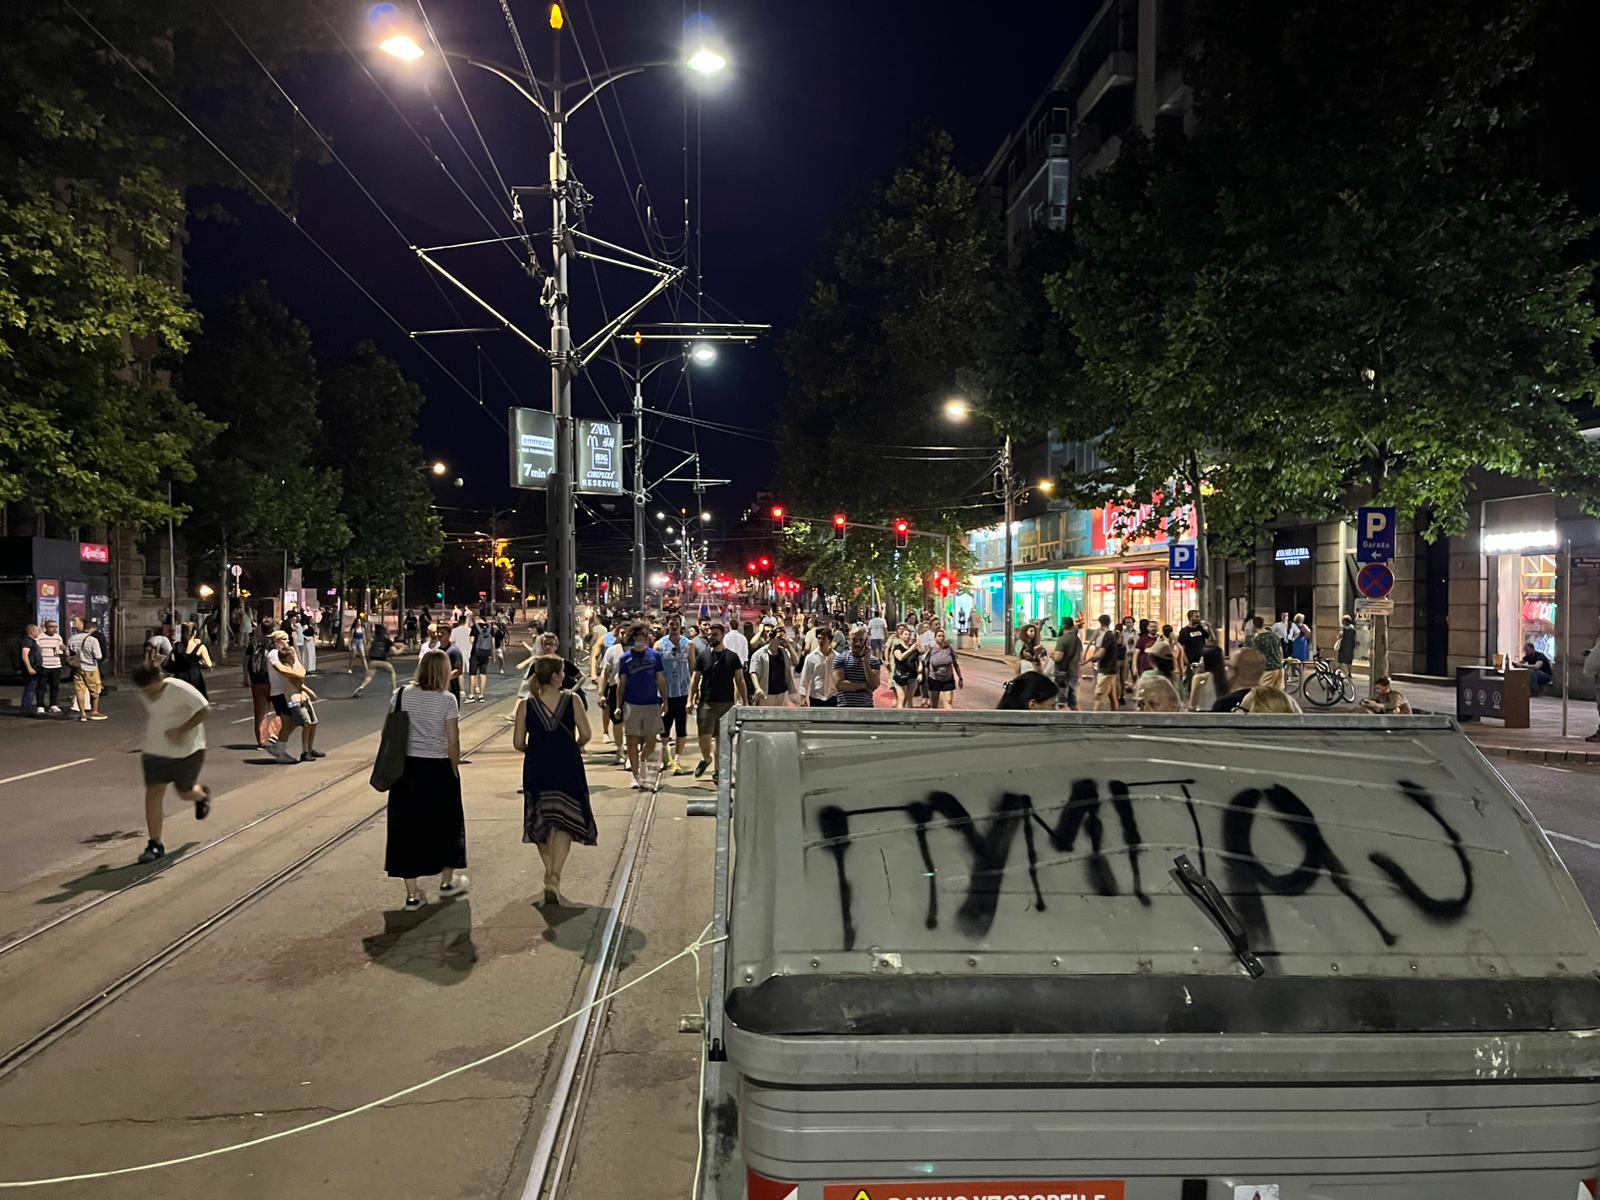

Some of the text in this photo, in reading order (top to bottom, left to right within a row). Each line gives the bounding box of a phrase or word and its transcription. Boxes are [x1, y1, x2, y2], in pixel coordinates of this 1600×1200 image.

[590, 422, 611, 436] ZARA
[595, 453, 609, 461] BIG
[581, 479, 620, 489] RESERVED
[1366, 512, 1387, 539] P
[1174, 547, 1190, 567] P
